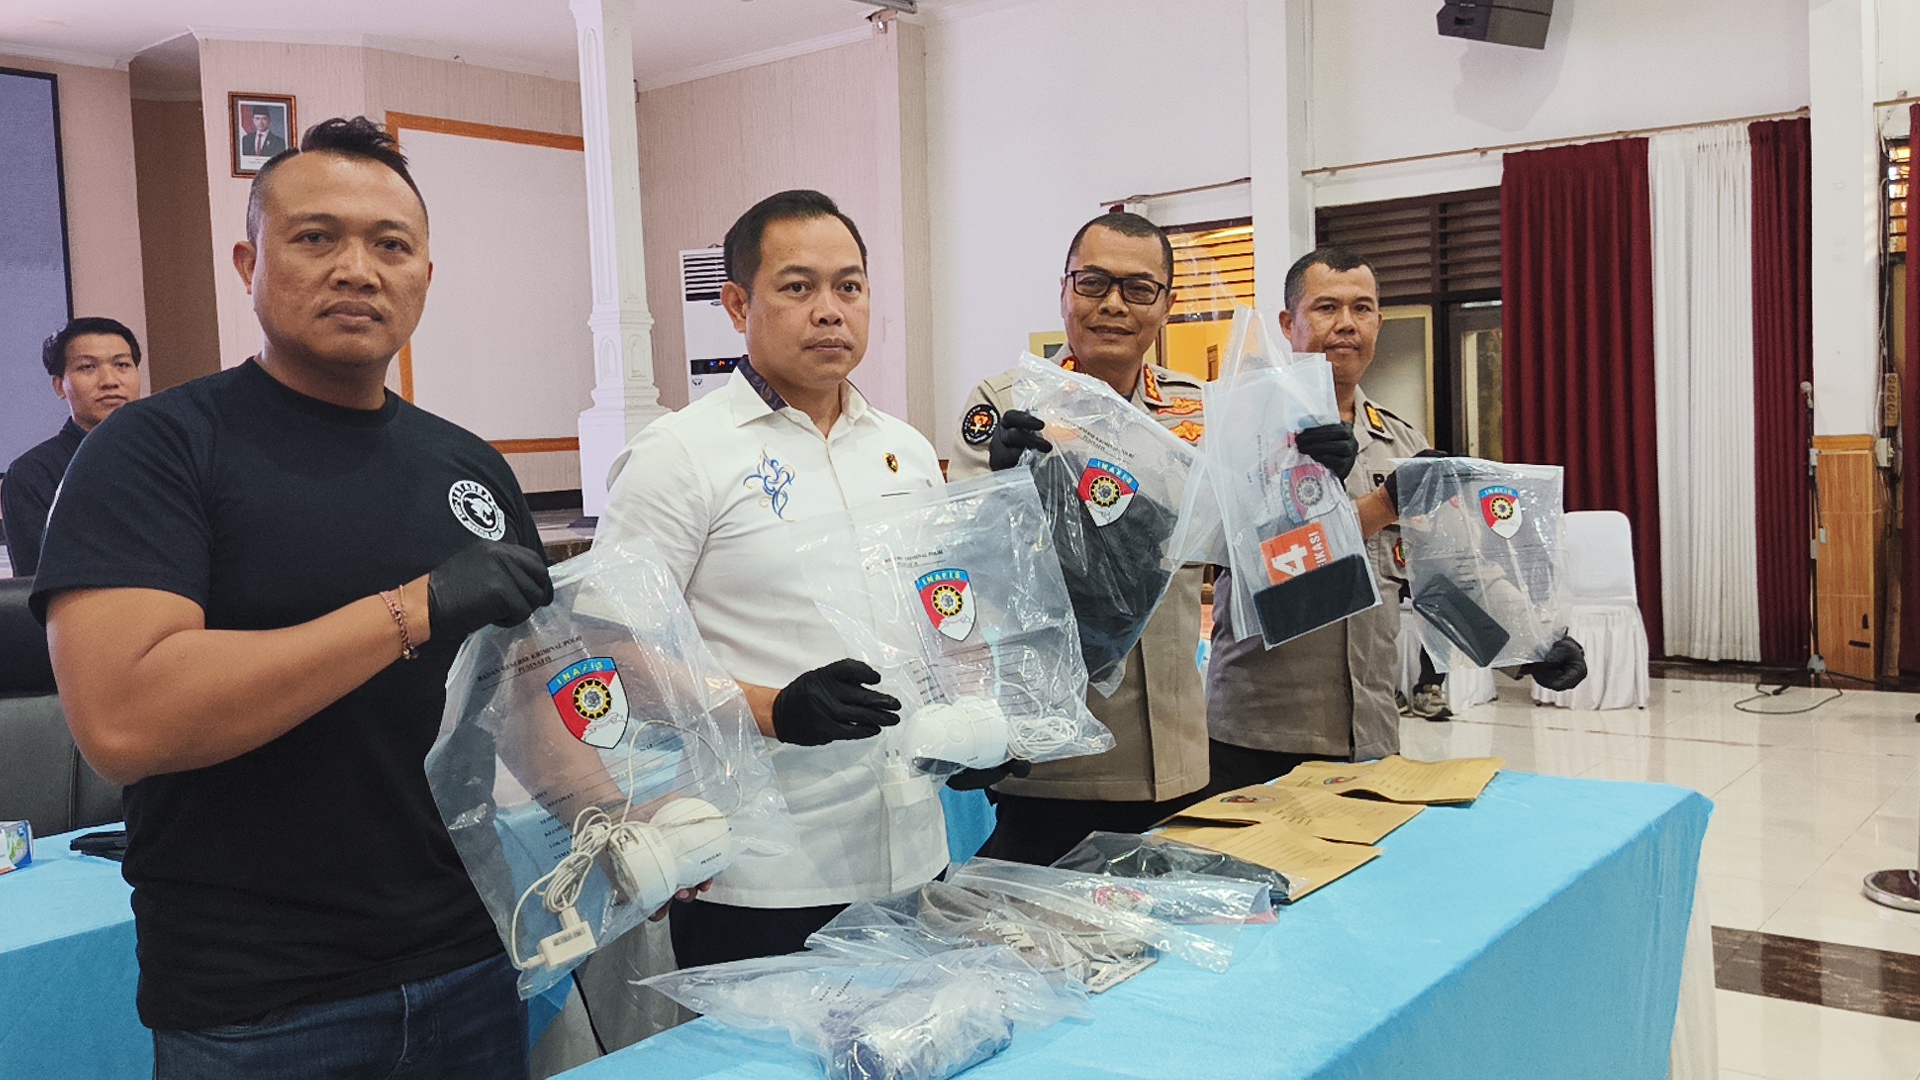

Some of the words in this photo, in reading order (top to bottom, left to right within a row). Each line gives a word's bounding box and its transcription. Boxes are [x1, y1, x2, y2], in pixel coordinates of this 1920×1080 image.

[1270, 543, 1309, 578] 4
[1308, 530, 1327, 567] IKASI
[556, 661, 605, 685] INAFIS
